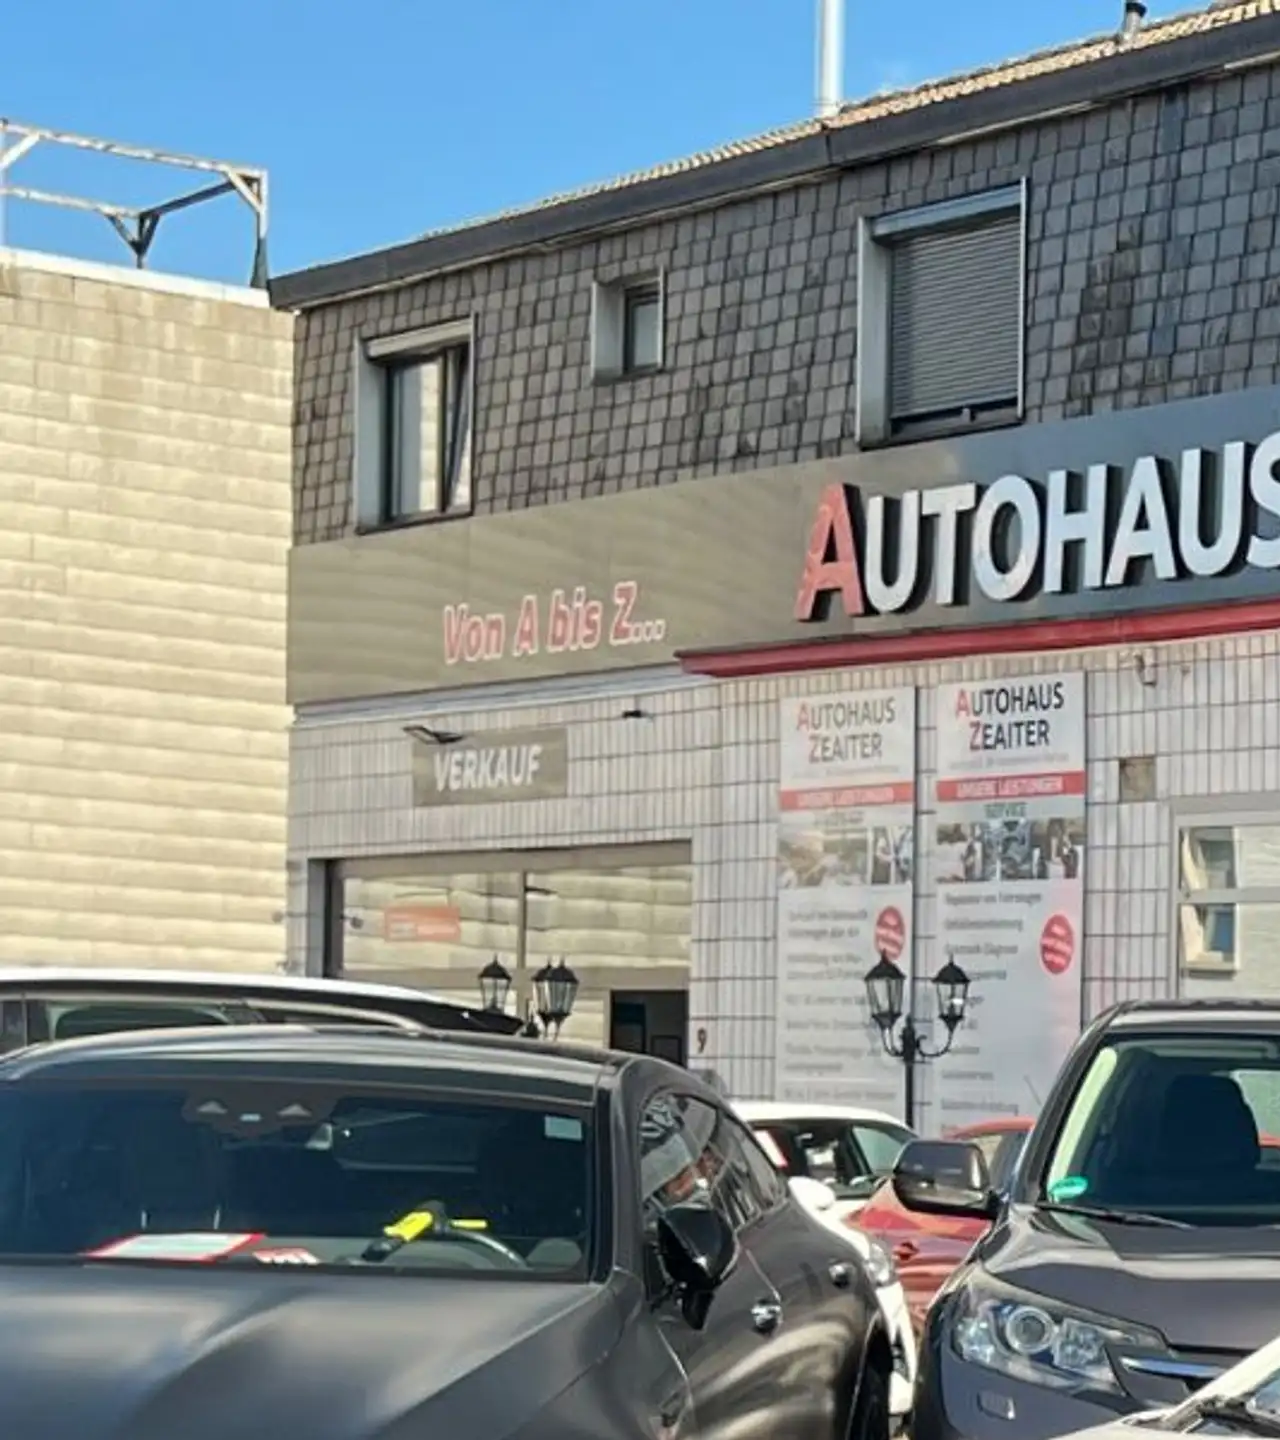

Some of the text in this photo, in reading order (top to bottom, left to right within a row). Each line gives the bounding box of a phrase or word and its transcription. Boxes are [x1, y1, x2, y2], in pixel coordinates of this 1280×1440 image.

[443, 581, 667, 665] Von A bis Z...
[796, 696, 896, 731] AUTOHAUS
[955, 682, 1065, 718] AUTOHAUS
[808, 732, 883, 763] ZEAITER
[969, 720, 1050, 751] ZEAITER
[434, 742, 542, 793] VERKAUF
